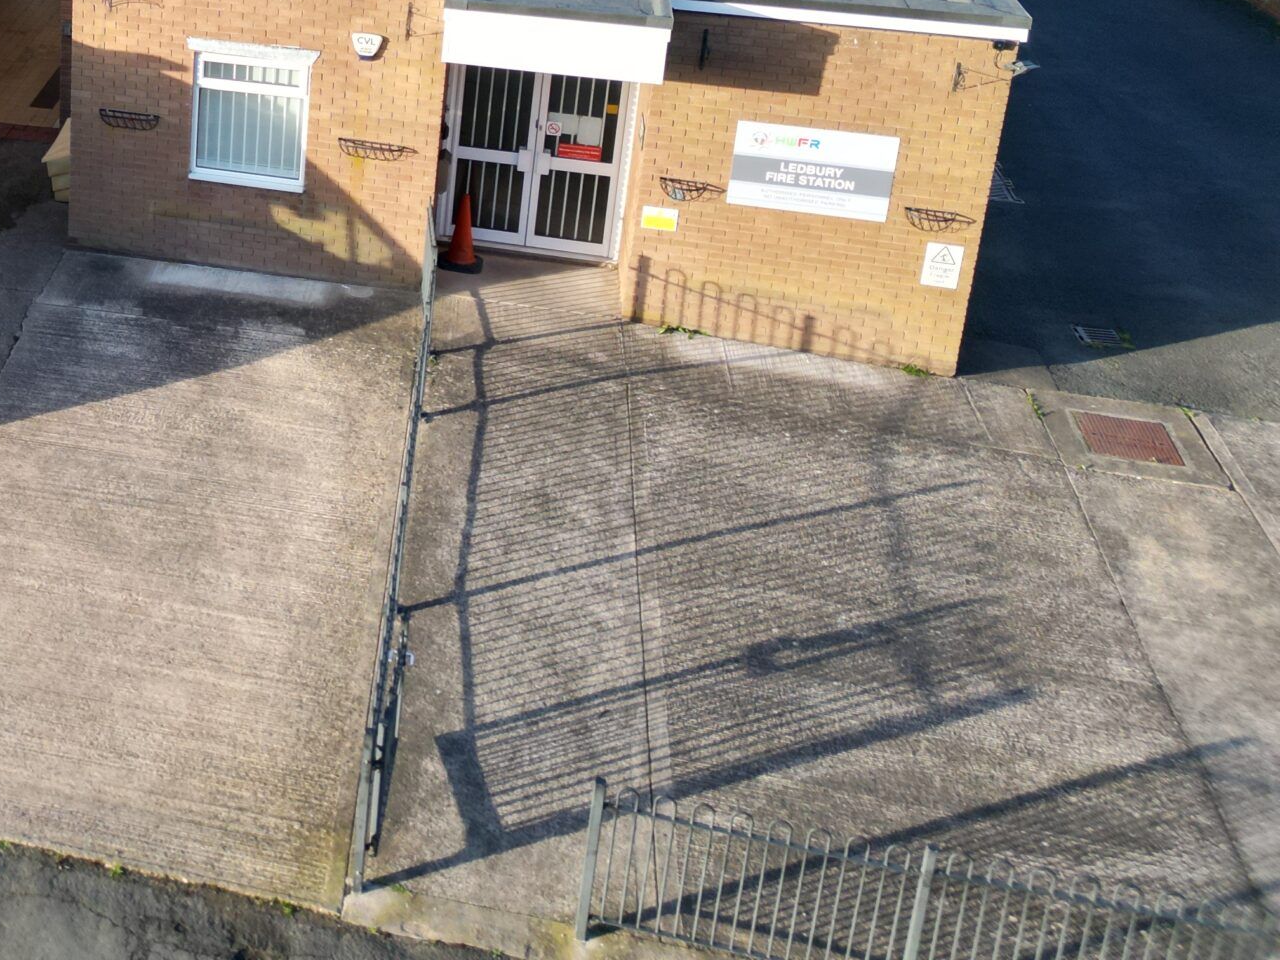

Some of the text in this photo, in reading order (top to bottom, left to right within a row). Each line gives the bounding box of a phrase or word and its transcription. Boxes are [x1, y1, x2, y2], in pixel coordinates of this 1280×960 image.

[357, 36, 376, 46] CVL
[775, 136, 821, 150] HWFR
[780, 161, 844, 178] LEDBURY
[765, 171, 856, 191] FIRE STATION
